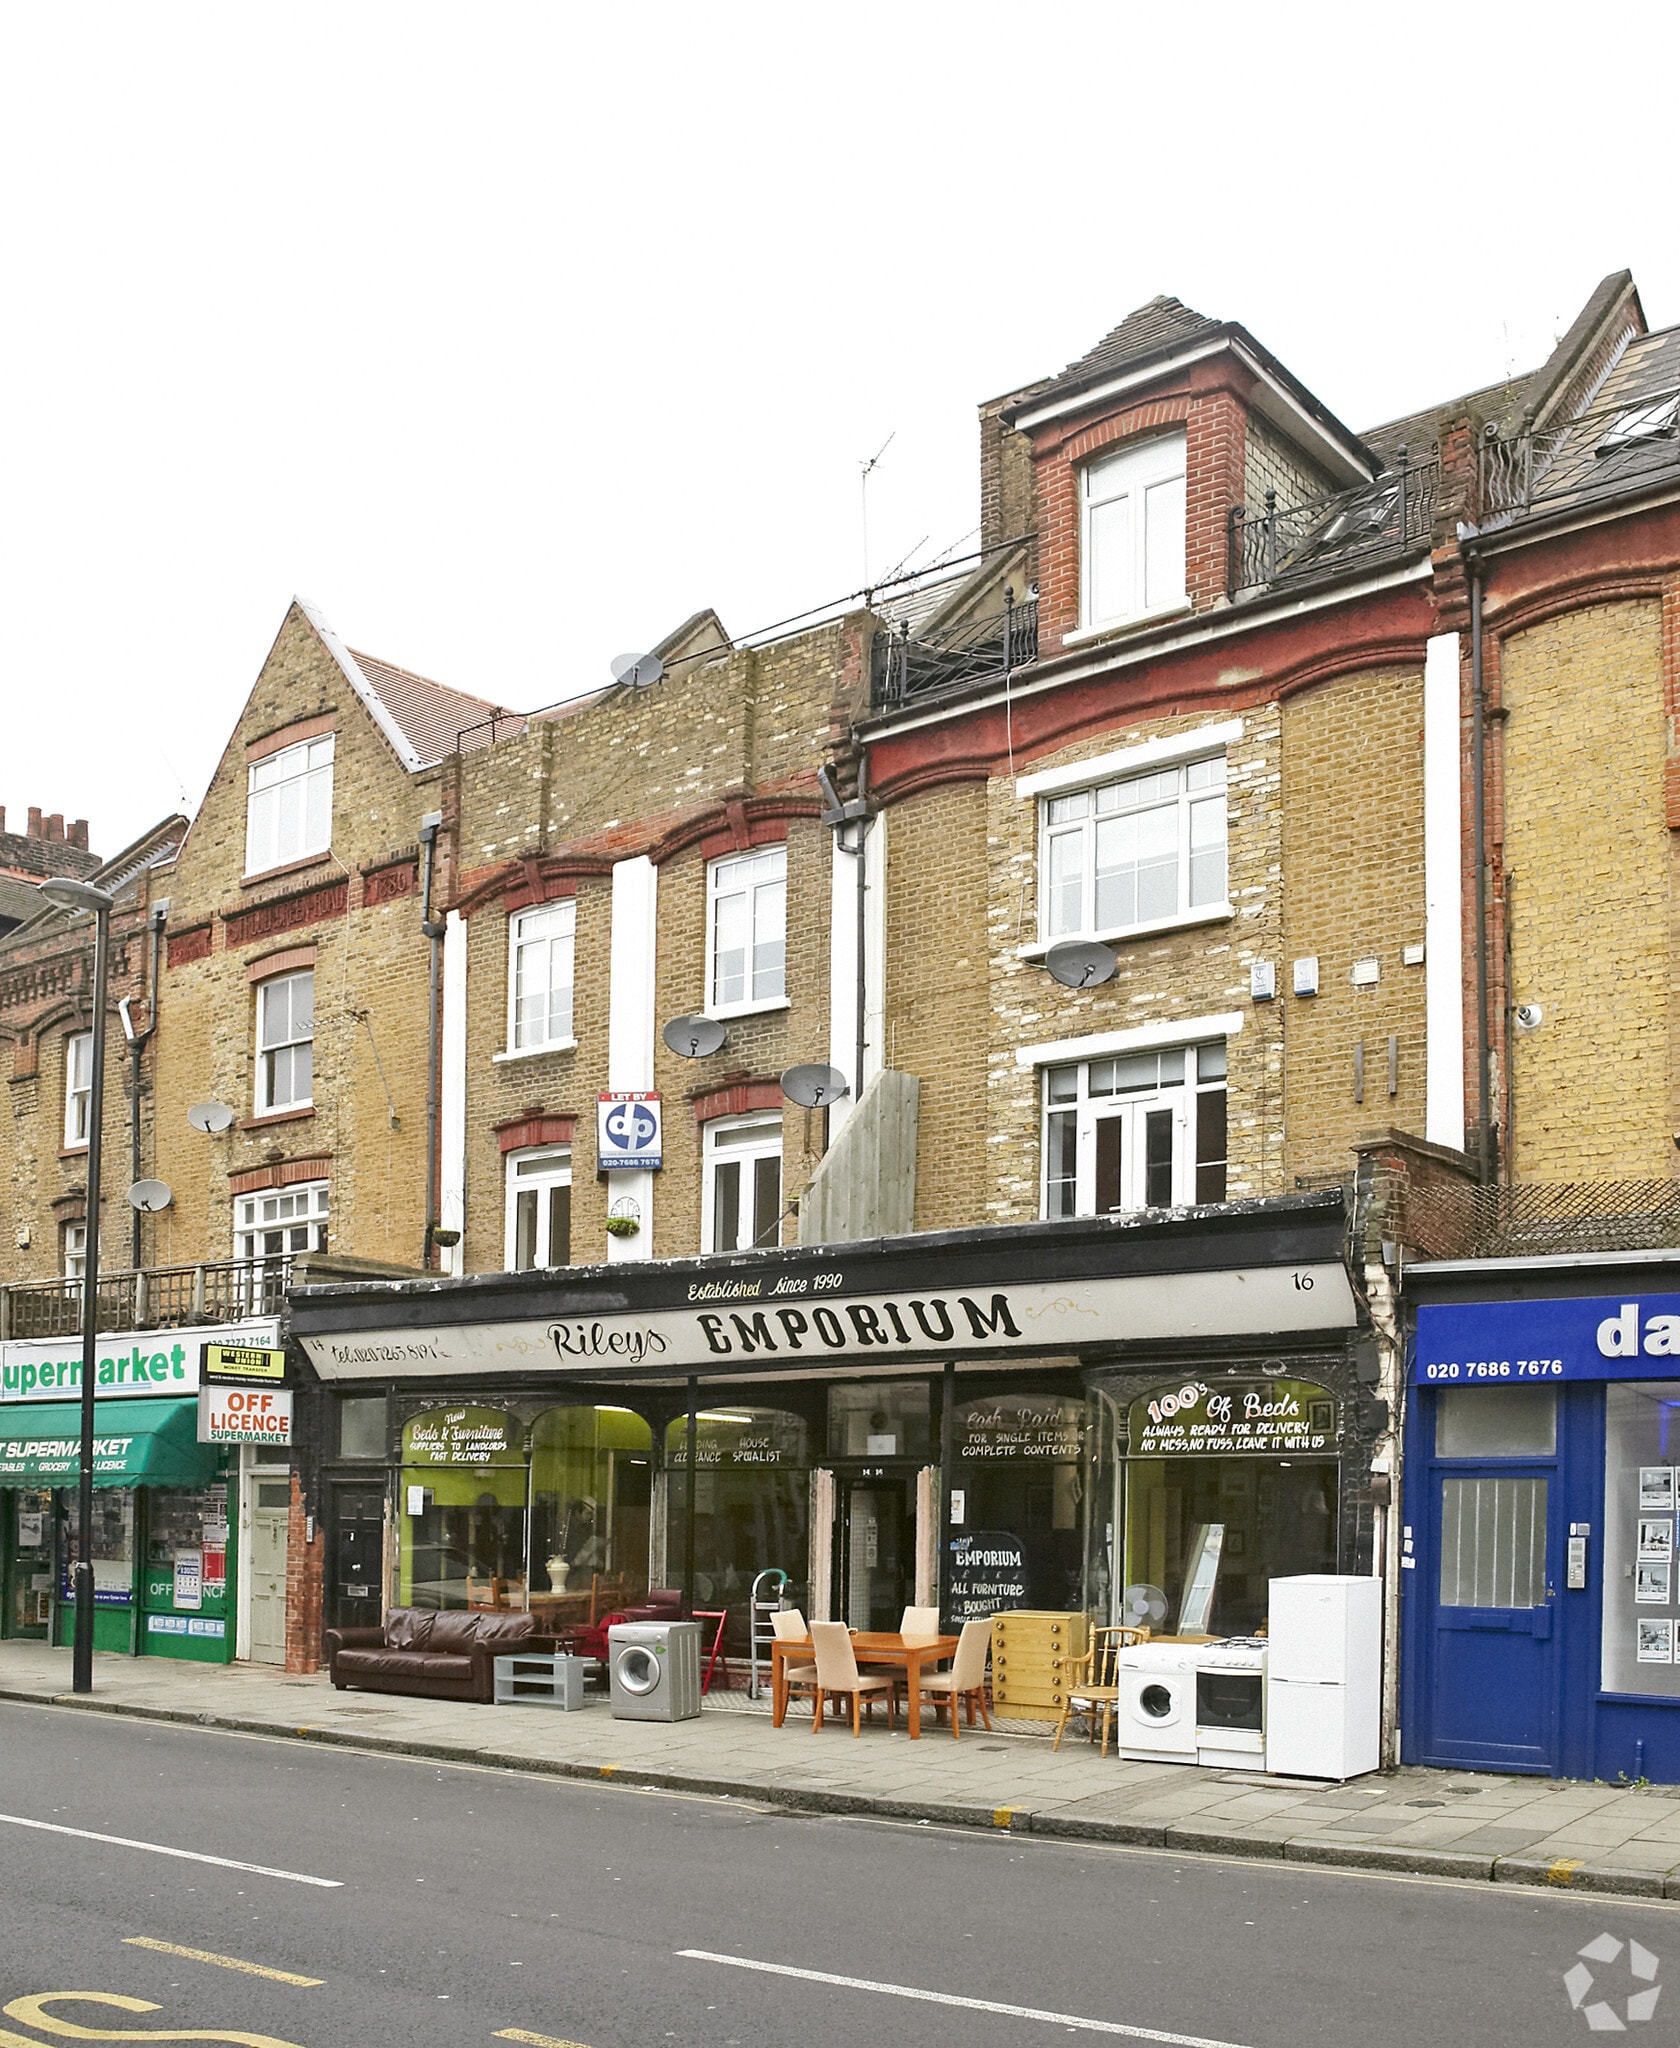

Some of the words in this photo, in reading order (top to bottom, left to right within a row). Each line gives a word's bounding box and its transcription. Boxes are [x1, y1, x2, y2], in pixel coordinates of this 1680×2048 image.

[688, 1279, 762, 1301] Established
[768, 1276, 807, 1295] since
[812, 1273, 843, 1290] 1990
[1291, 1270, 1314, 1291] 16
[696, 1293, 1023, 1353] EMPORIUM
[249, 1336, 271, 1346] 7164
[547, 1322, 673, 1363] Rileys
[222, 1350, 262, 1360] WESTERN
[235, 1357, 262, 1365] UNION
[1427, 1363, 1460, 1379] 020
[1466, 1361, 1511, 1377] 7686
[1517, 1360, 1563, 1376] 7676
[228, 1392, 274, 1413] OFF
[1206, 1394, 1232, 1423] Of
[1244, 1392, 1300, 1420] Beds
[210, 1412, 289, 1432] LICENCE
[966, 1405, 1002, 1430] Cash
[1017, 1407, 1064, 1430] Paid
[210, 1430, 288, 1442] SUPERMARKET
[412, 1423, 439, 1440] Beds
[441, 1426, 449, 1441] &
[450, 1424, 504, 1441] Furniture
[1142, 1425, 1185, 1437] ALWAYS
[1190, 1424, 1227, 1436] READY
[1230, 1423, 1251, 1435] FOR
[1256, 1422, 1310, 1435] DELIVERY
[740, 1437, 770, 1449] HOUSE
[968, 1434, 988, 1444] FOR
[996, 1432, 1031, 1444] SINGLE
[1038, 1431, 1068, 1442] ITEMS
[1140, 1438, 1156, 1451] NO
[1272, 1436, 1282, 1448] IT
[1284, 1436, 1309, 1448] WITH
[1312, 1435, 1325, 1448] US
[409, 1442, 445, 1451] SUPPLIERS
[450, 1442, 461, 1451] TO
[465, 1441, 508, 1451] LANDLORDS
[962, 1445, 1016, 1456] COMPLETE
[1024, 1444, 1082, 1456] CONTENTS
[430, 1452, 448, 1461] FAST
[452, 1452, 491, 1462] DELIVERY
[38, 1462, 72, 1472] GROCERY
[96, 1460, 128, 1470] LICENCE
[956, 1550, 1022, 1566] EMPORIUM
[150, 1583, 173, 1596] OFF
[951, 1582, 968, 1595] ALL
[972, 1583, 1025, 1596] FURNITURE
[963, 1597, 1002, 1615] BOUGHT
